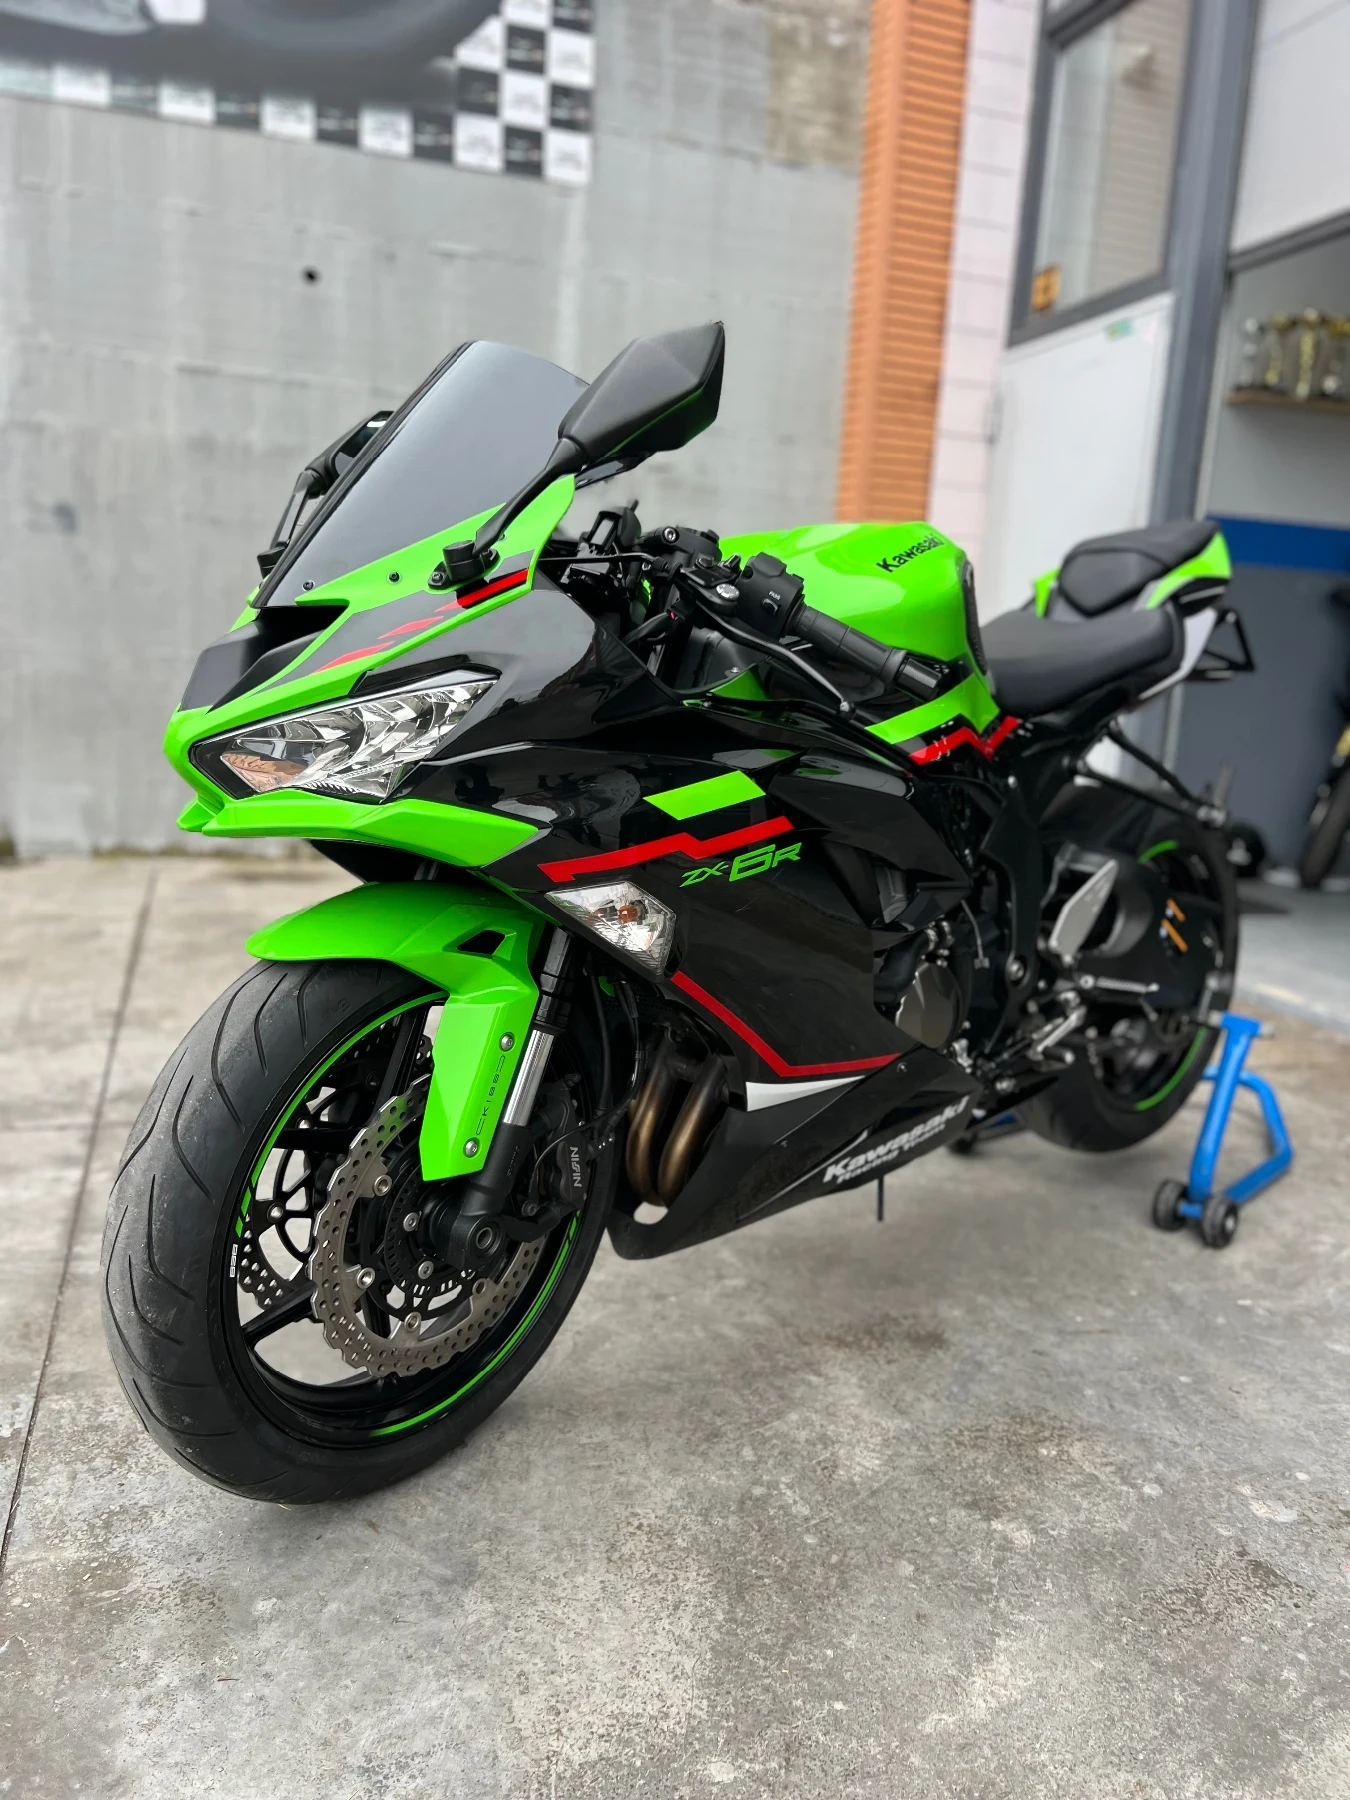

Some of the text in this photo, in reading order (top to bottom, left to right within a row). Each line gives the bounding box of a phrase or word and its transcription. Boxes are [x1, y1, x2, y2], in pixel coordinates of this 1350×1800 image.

[876, 534, 944, 573] Kawasaki
[679, 842, 802, 888] ZX-6R
[822, 1095, 970, 1184] Kawasaki
